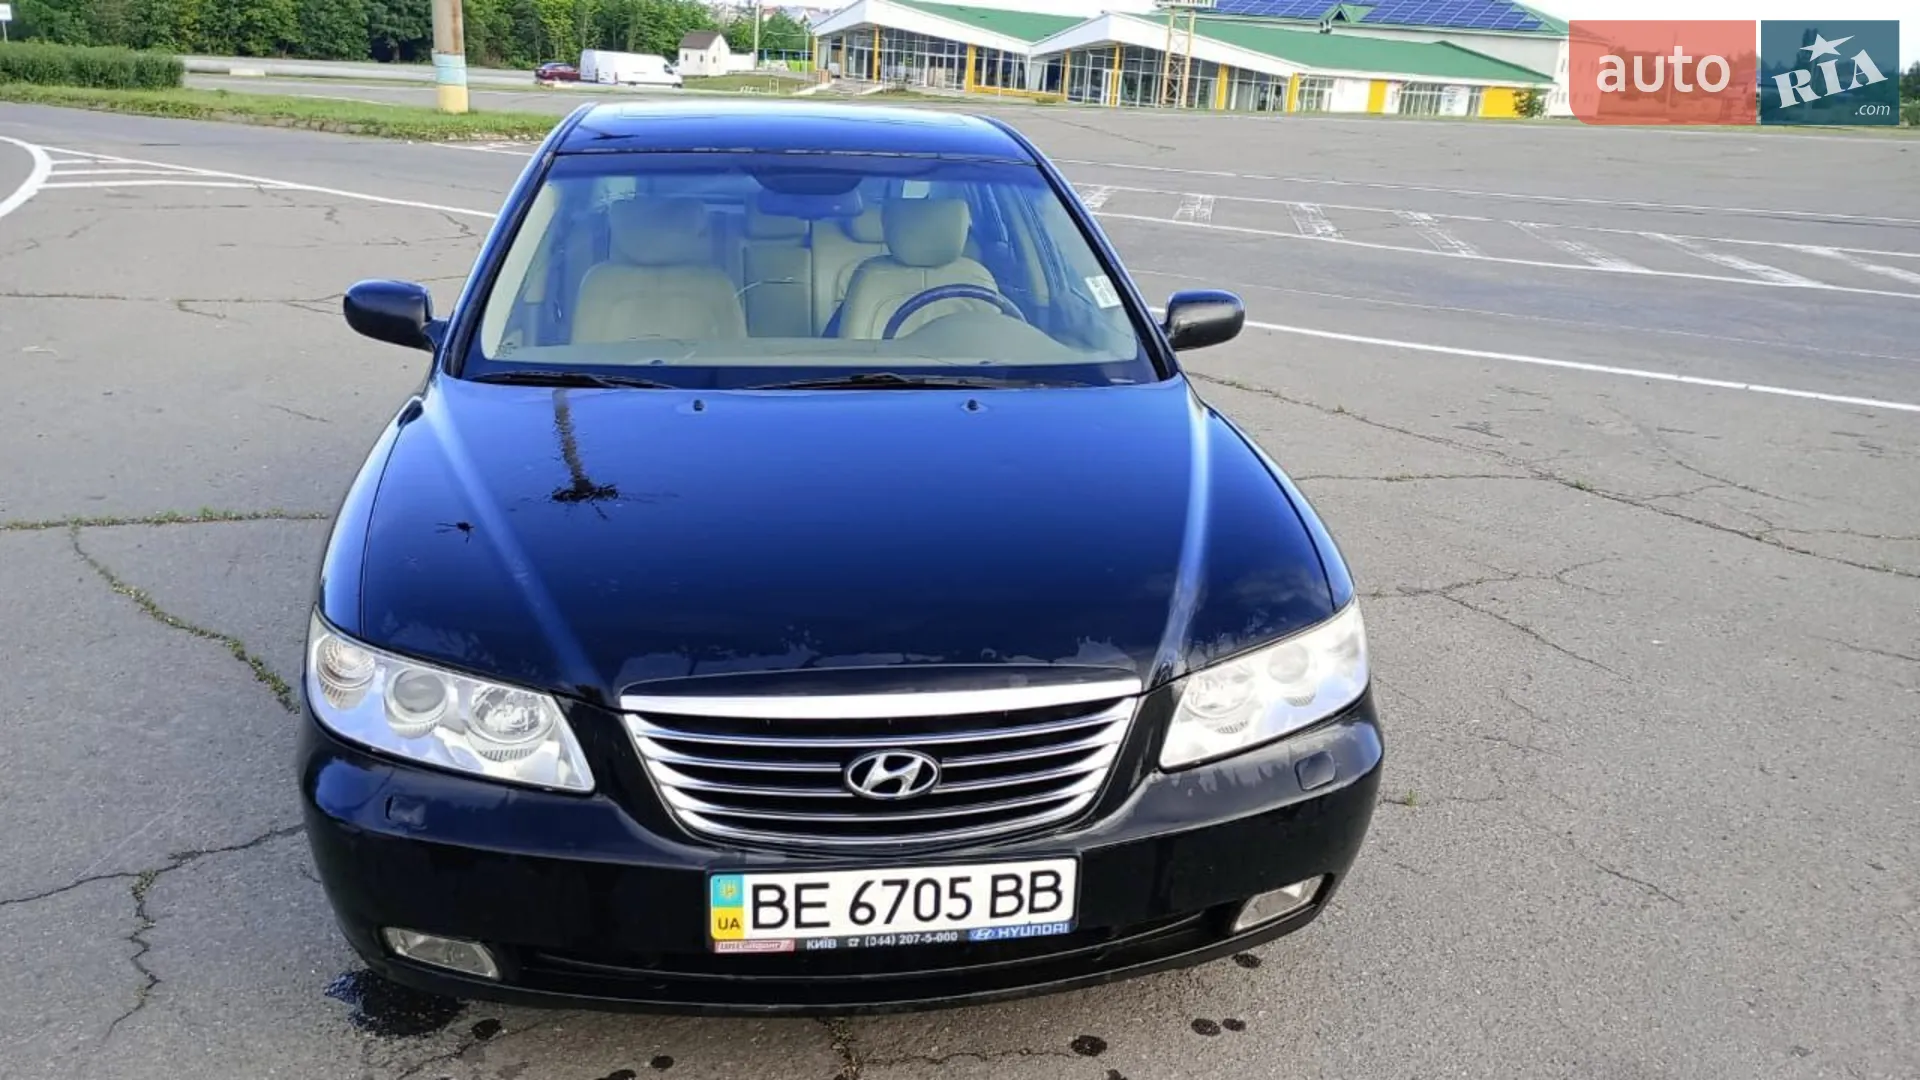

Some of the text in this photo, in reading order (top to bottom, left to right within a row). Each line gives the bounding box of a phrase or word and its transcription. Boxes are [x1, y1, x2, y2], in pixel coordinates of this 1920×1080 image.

[752, 870, 1063, 929] BE 6705 BB
[718, 918, 741, 930] UA
[998, 923, 1069, 938] HYUNDAI
[806, 936, 837, 950] КИЇВ
